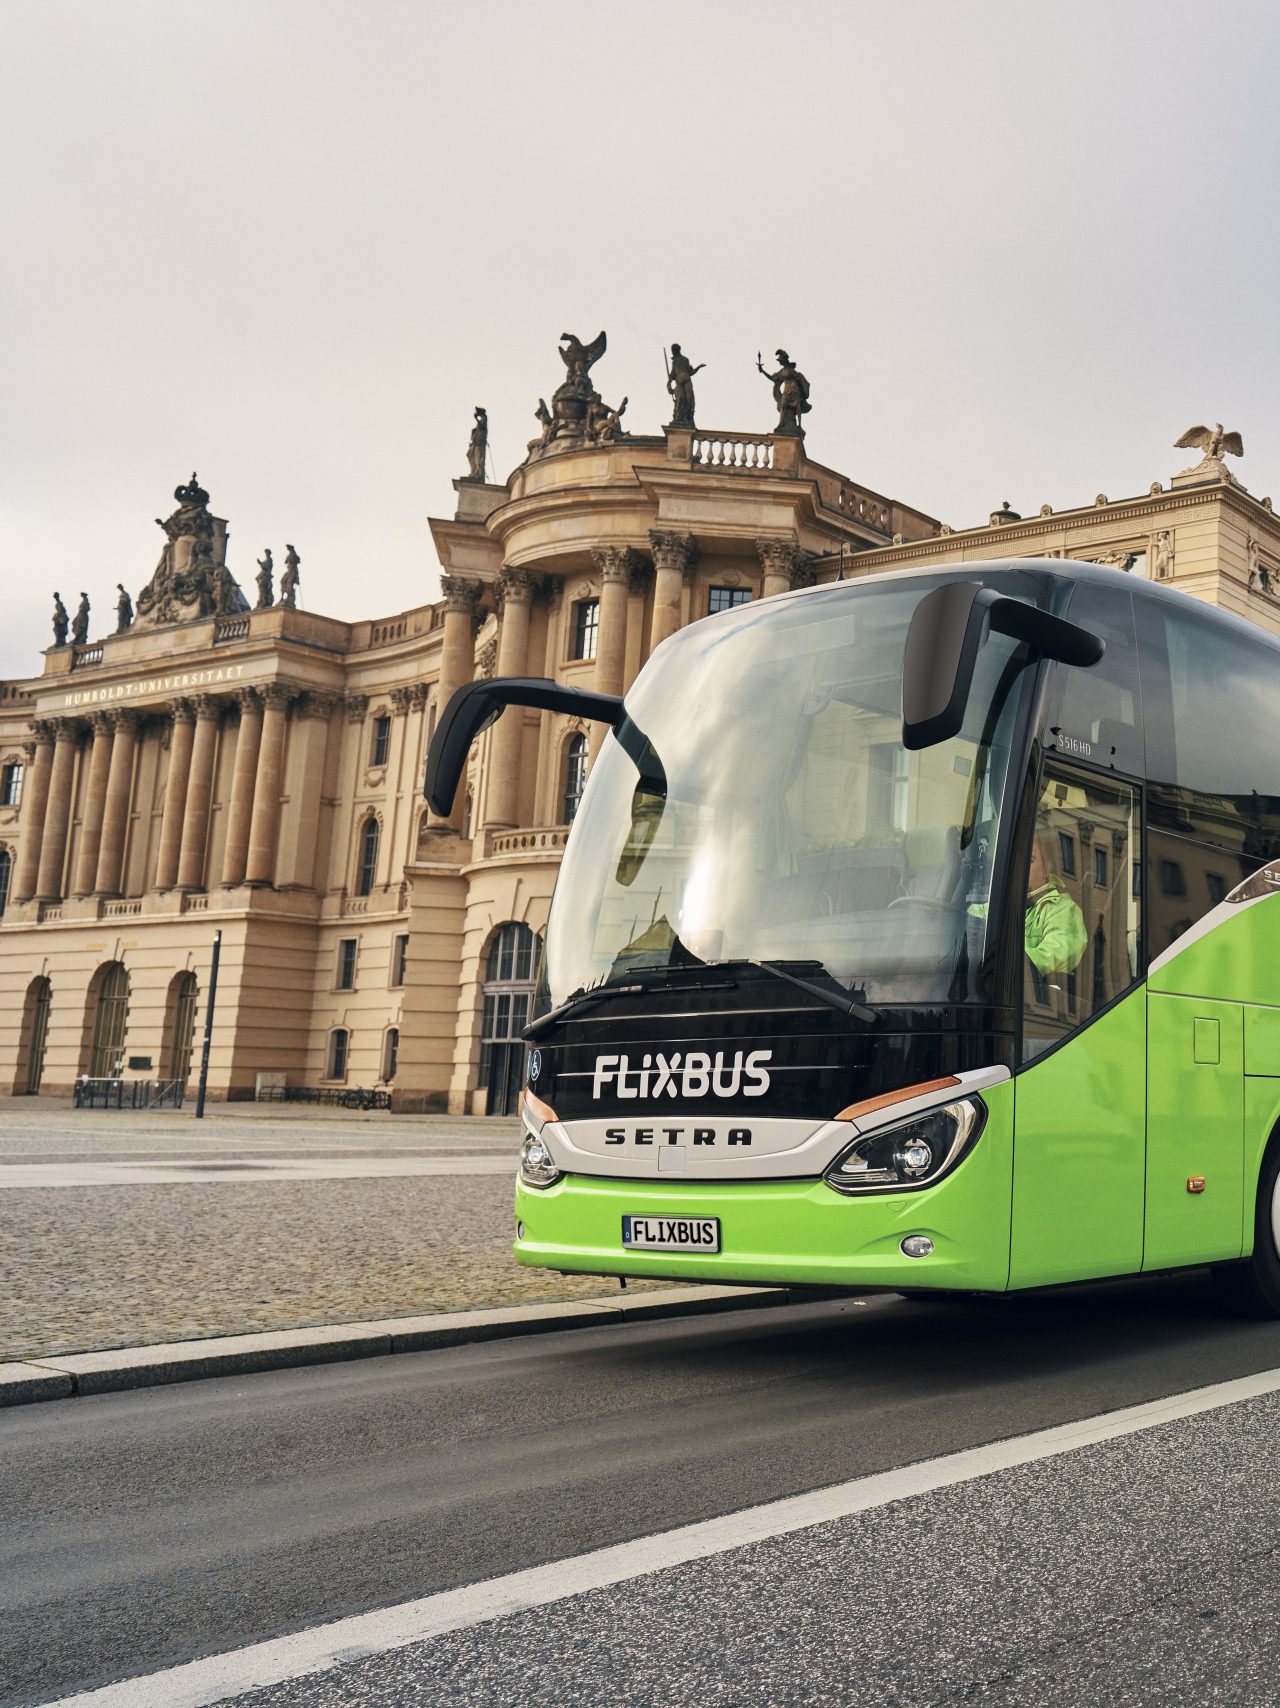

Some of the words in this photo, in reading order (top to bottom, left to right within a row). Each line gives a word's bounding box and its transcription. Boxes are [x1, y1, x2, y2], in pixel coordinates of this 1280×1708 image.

[1058, 734, 1064, 747] S
[1065, 737, 1078, 752] 516
[1080, 741, 1091, 755] HD
[604, 1128, 752, 1146] SETRA
[633, 1220, 714, 1245] FLIXBUS
